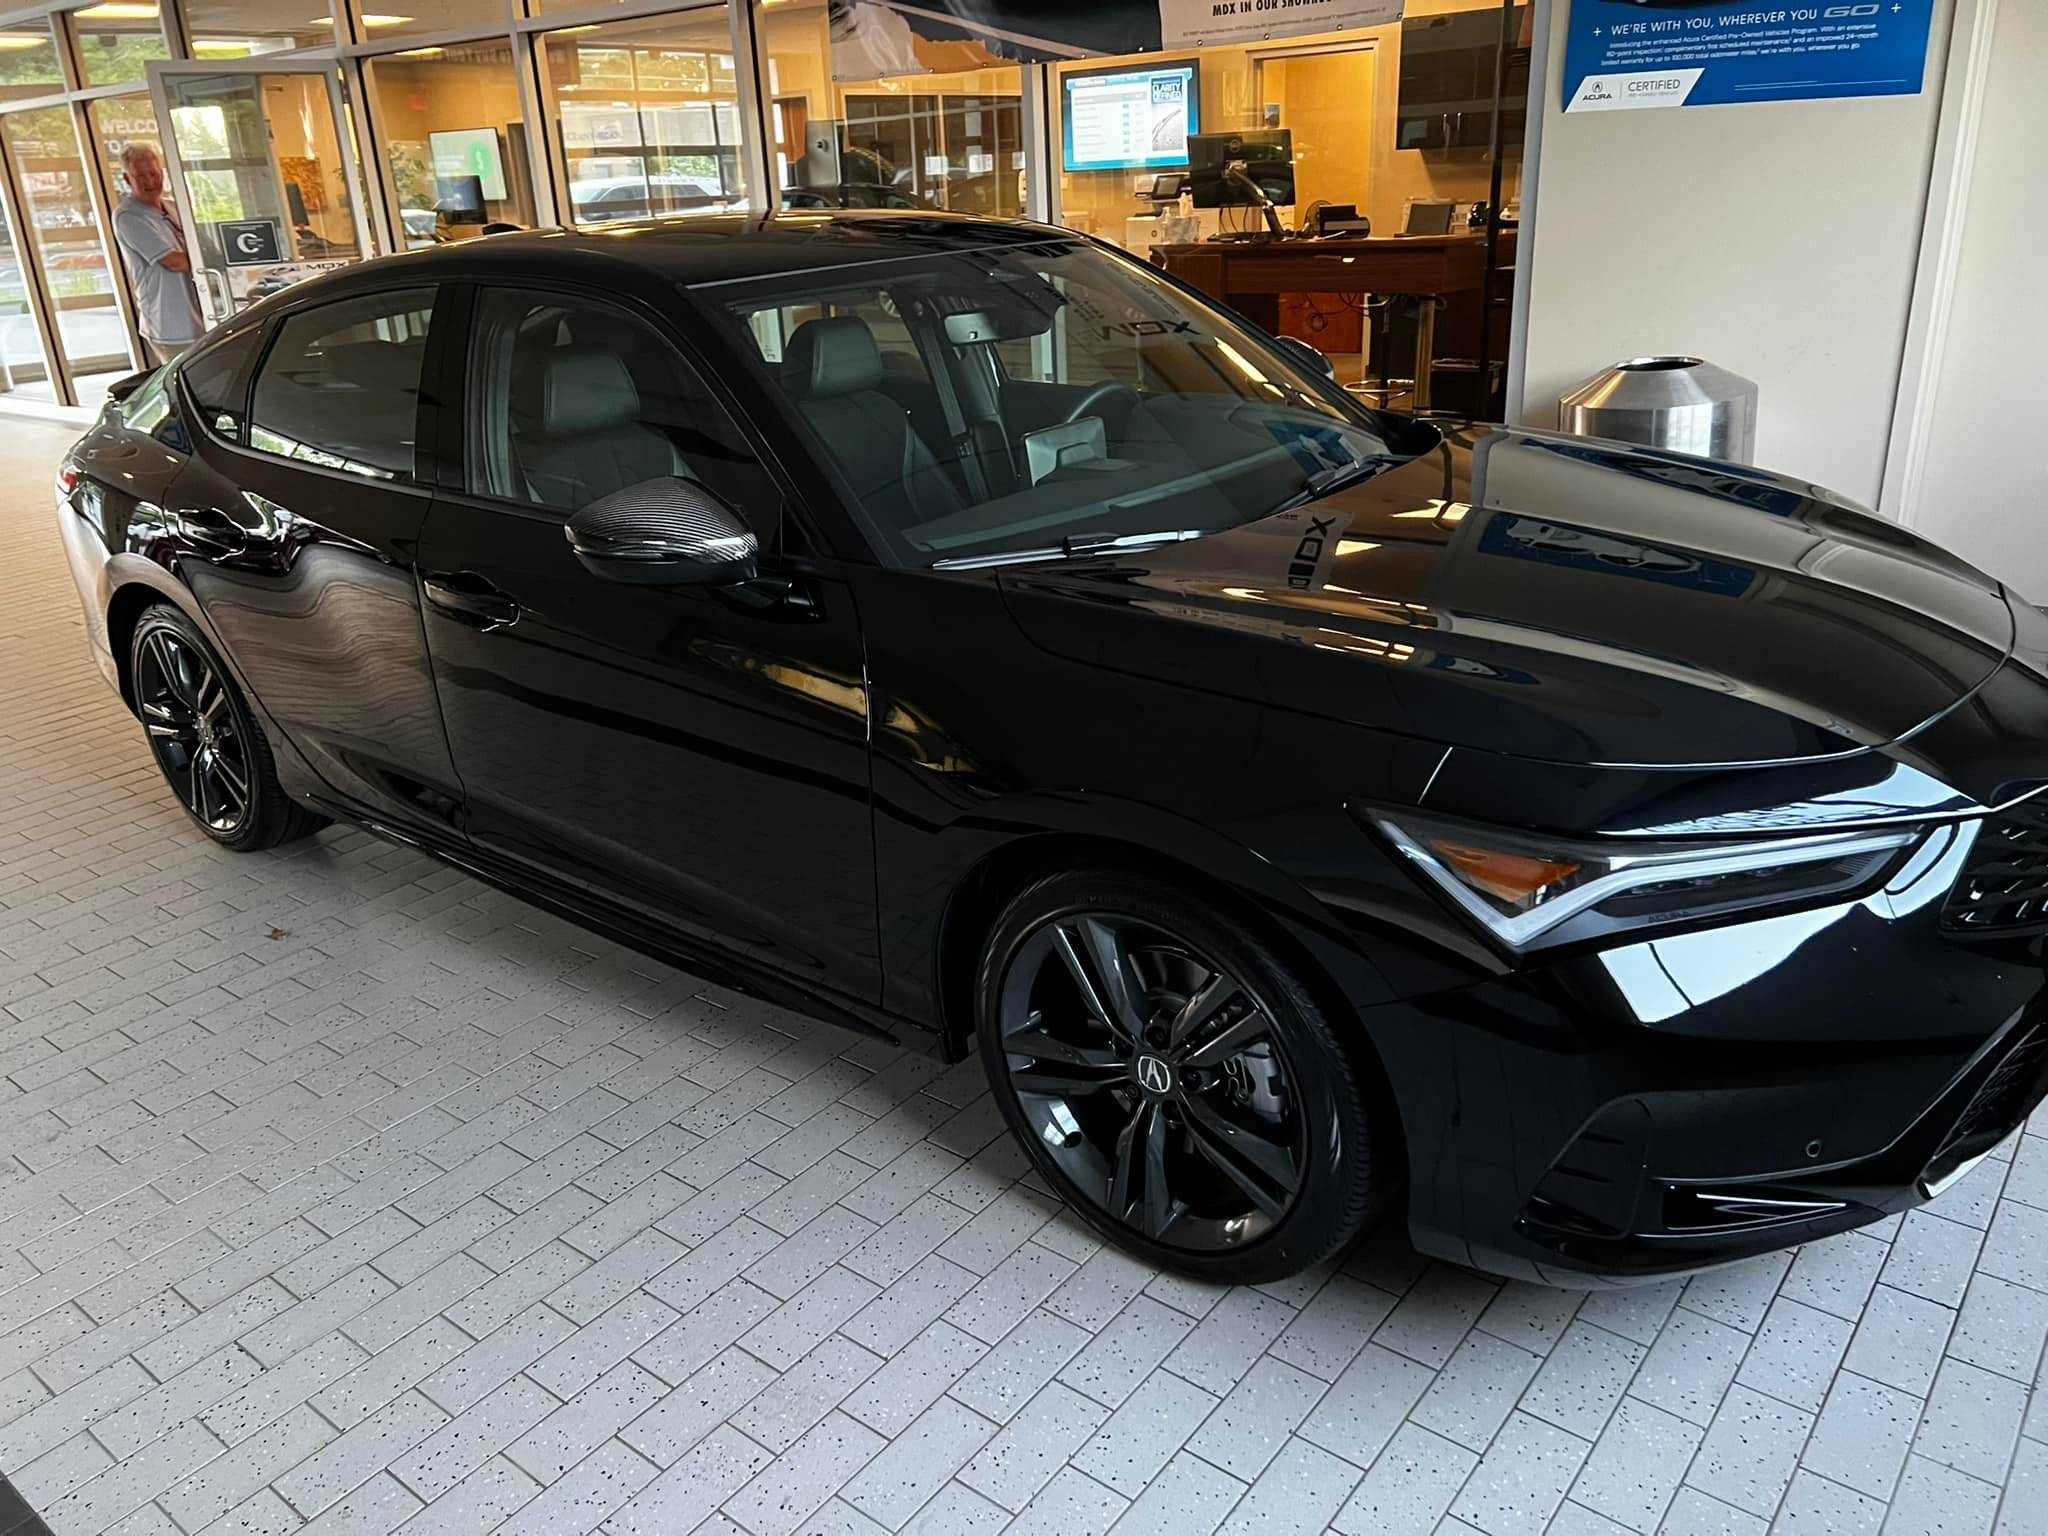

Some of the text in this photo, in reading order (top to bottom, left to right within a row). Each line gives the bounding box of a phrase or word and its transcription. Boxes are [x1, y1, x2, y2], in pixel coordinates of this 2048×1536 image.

[1212, 4, 1236, 17] MDX
[1240, 2, 1252, 13] IN
[1256, 0, 1278, 11] OUR
[1651, 20, 1681, 32] WITH
[1685, 17, 1714, 30] YOU,
[1718, 11, 1786, 27] WHEREVER
[1790, 9, 1818, 21] YOU
[1824, 3, 1880, 18] GO
[1628, 79, 1681, 92] CERTIFIED
[1583, 93, 1613, 101] ACURA
[101, 118, 159, 134] WELCO
[306, 260, 348, 271] MDX
